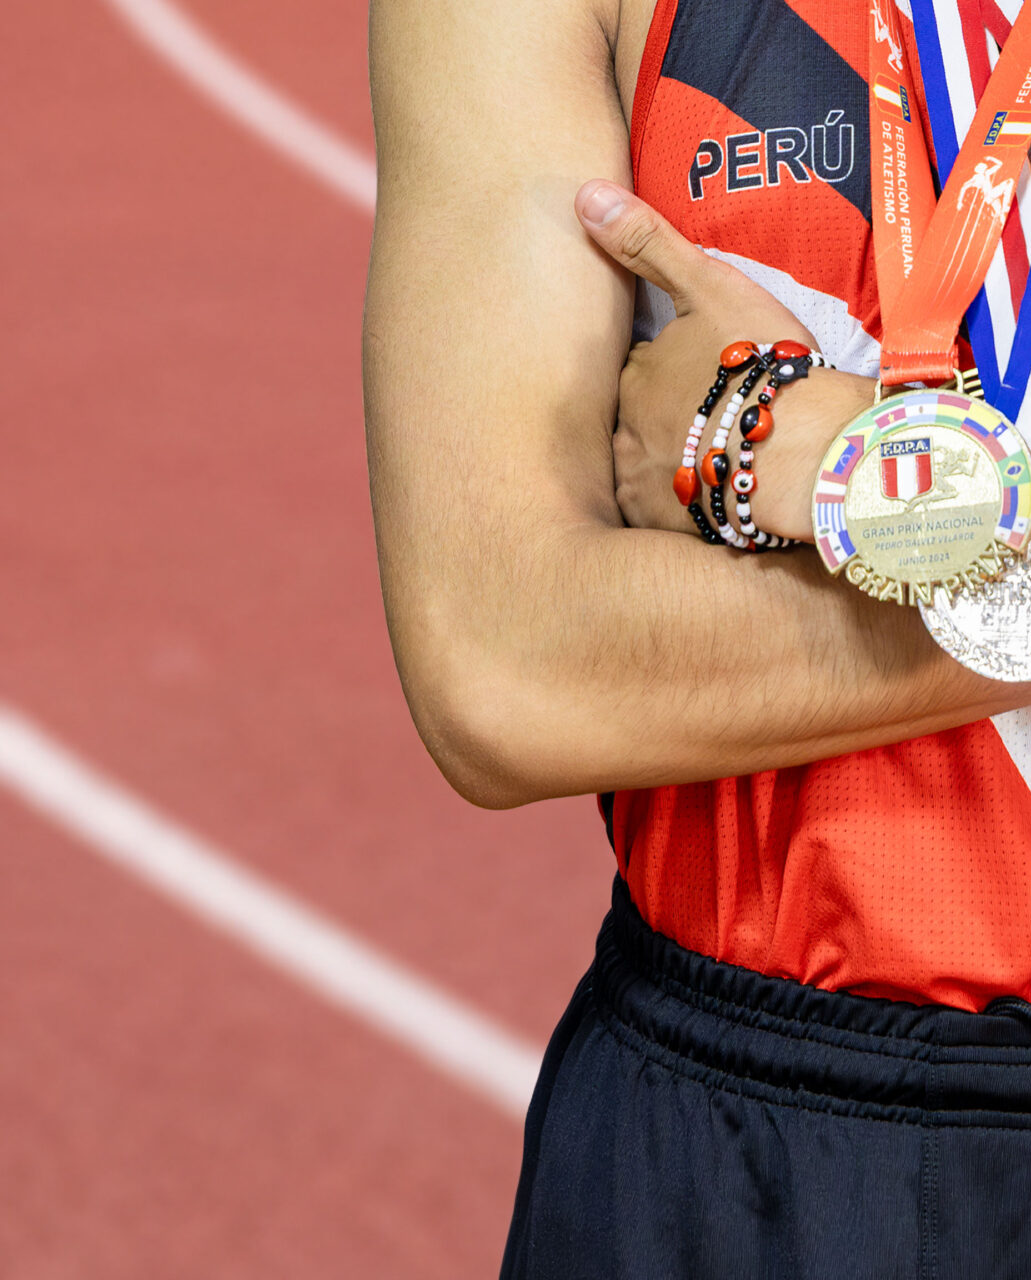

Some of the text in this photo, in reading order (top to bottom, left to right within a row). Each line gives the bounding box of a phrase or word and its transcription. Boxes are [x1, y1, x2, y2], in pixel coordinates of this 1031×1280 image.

[688, 109, 855, 201] PERÚ
[882, 121, 896, 224] DE ATLETISMO
[895, 125, 914, 279] FEDERACIÓN PERUAN
[882, 439, 929, 456] F.D.P.A.
[862, 516, 984, 539] GRAN PRIX NACIONAL
[874, 540, 903, 551] PEDRO
[938, 532, 975, 543] VELARDE
[846, 539, 1011, 606] GRAN PRIX
[898, 554, 926, 567] JUNIO
